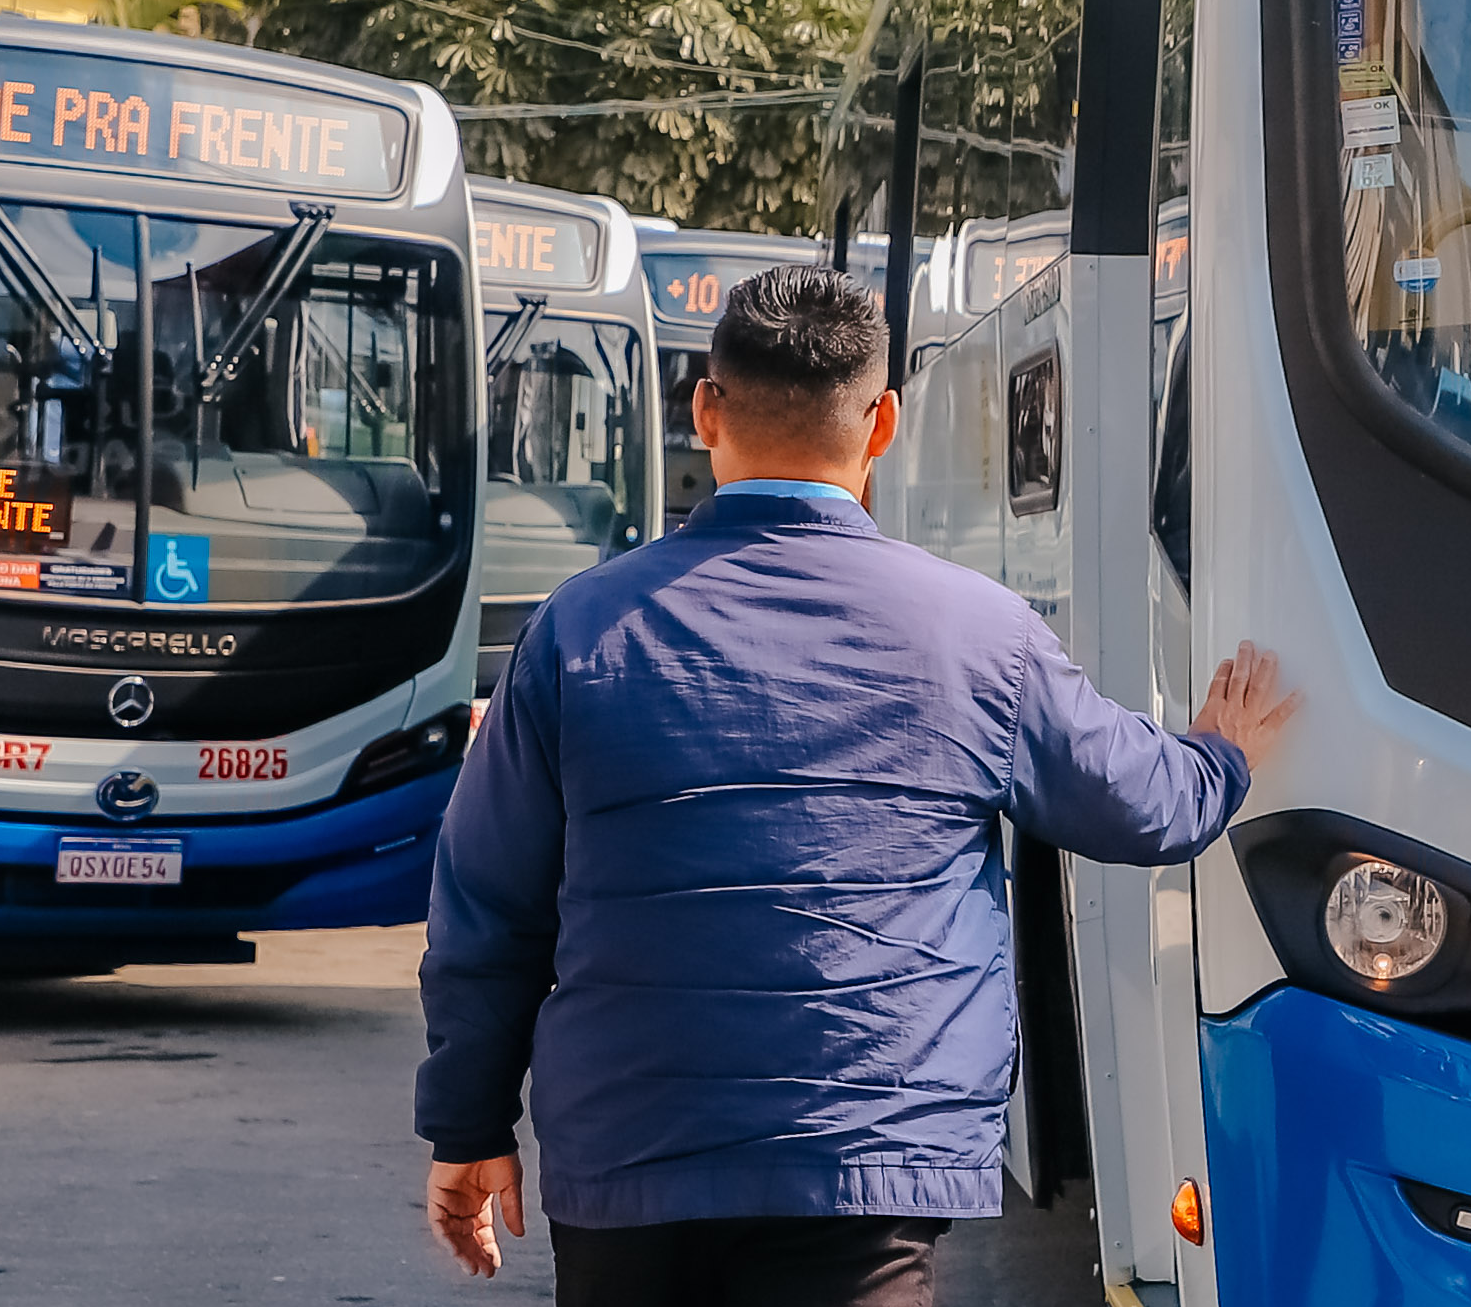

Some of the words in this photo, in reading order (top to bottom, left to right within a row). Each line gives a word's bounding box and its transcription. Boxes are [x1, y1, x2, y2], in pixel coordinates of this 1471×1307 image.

[1373, 100, 1391, 110] OK
[52, 87, 150, 156] PRA
[168, 101, 349, 178] FRENTE
[666, 271, 720, 314] +10
[42, 625, 238, 657] MASCARELLO
[198, 748, 288, 779] 26825
